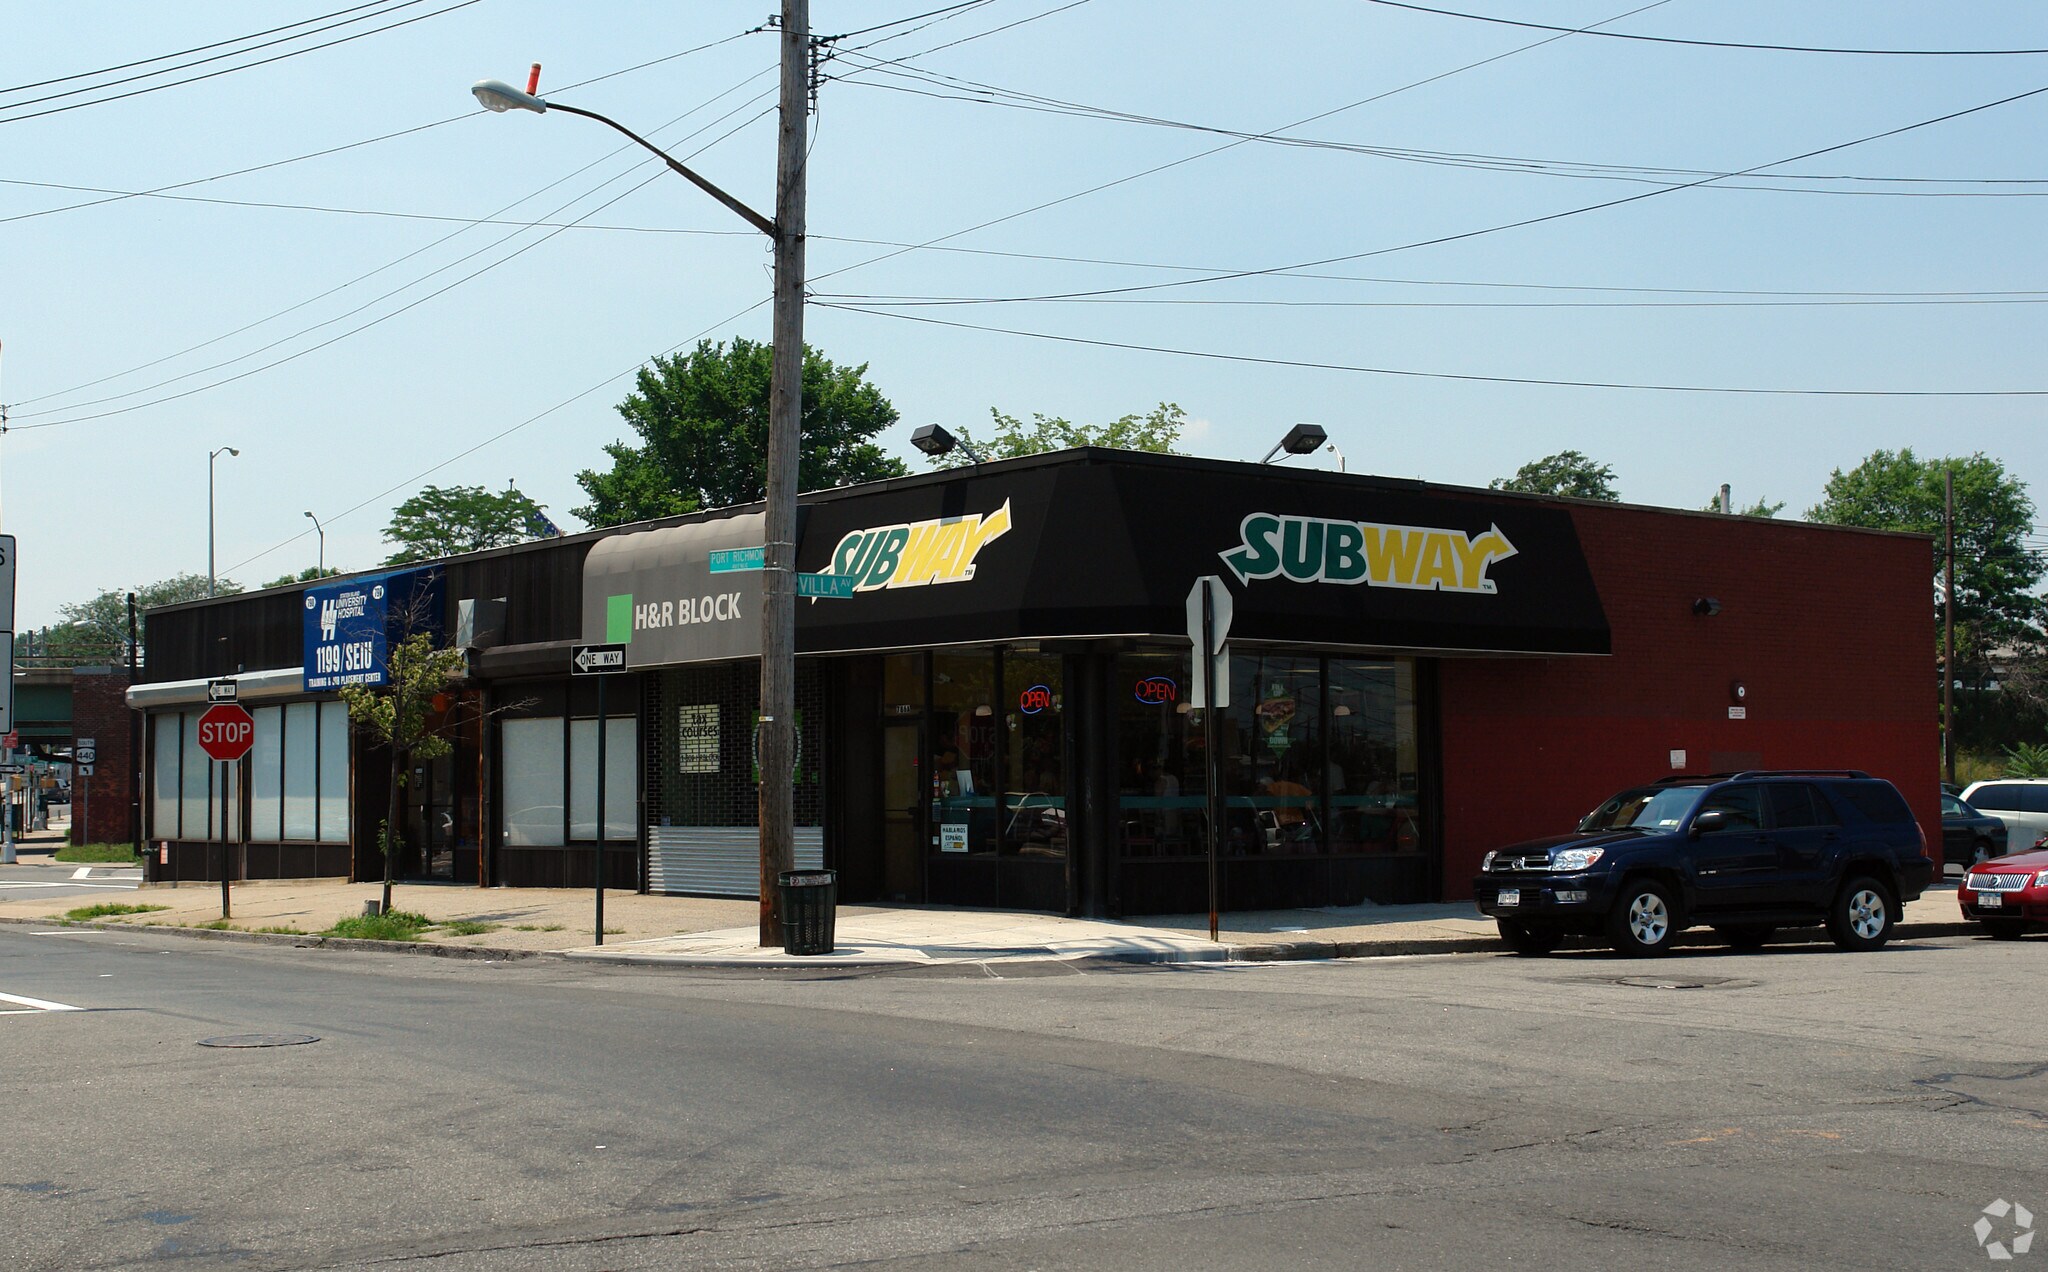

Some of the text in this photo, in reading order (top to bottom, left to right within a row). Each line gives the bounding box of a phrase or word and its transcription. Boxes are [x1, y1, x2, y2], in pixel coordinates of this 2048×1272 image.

[817, 501, 1010, 595] SUBWAY
[1222, 514, 1515, 591] SUBWAY
[711, 549, 765, 564] PORT RICHMON
[799, 576, 851, 595] VILLA AV
[336, 594, 367, 609] UNIVERSITY
[337, 605, 364, 619] HOSPITAL
[635, 592, 741, 630] H&R BLOCK
[316, 641, 372, 674] 1199/SEIU
[580, 652, 619, 665] ONE WAY
[224, 686, 234, 694] WAY
[1134, 680, 1176, 701] OPEN
[1020, 691, 1050, 708] OPEN
[692, 713, 707, 725] tax
[202, 722, 251, 743] STOP
[682, 726, 717, 738] courses
[77, 752, 95, 760] 440
